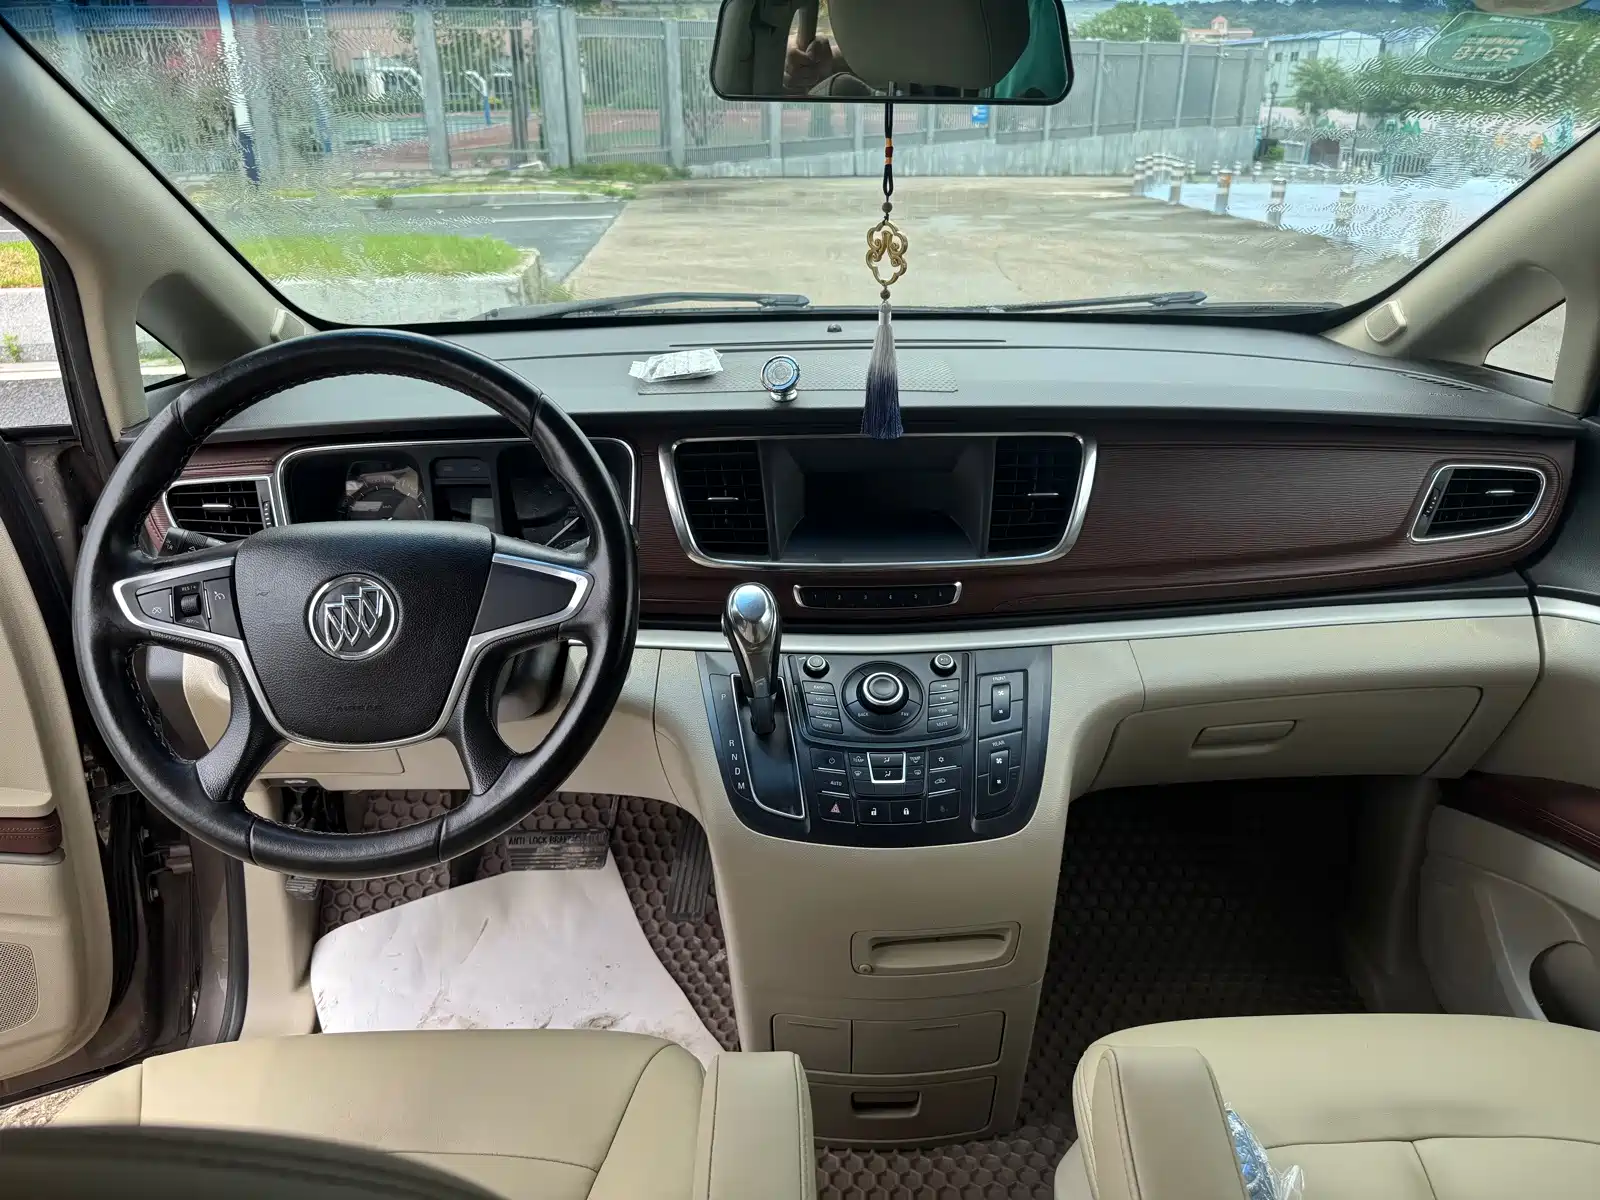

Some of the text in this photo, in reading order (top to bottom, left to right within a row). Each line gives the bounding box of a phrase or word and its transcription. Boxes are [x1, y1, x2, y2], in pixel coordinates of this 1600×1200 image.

[721, 693, 727, 701] P
[728, 739, 735, 747] R
[731, 753, 738, 761] N
[734, 767, 741, 776] D
[737, 782, 745, 790] M
[508, 836, 526, 845] ANTI
[528, 835, 548, 844] LOCK
